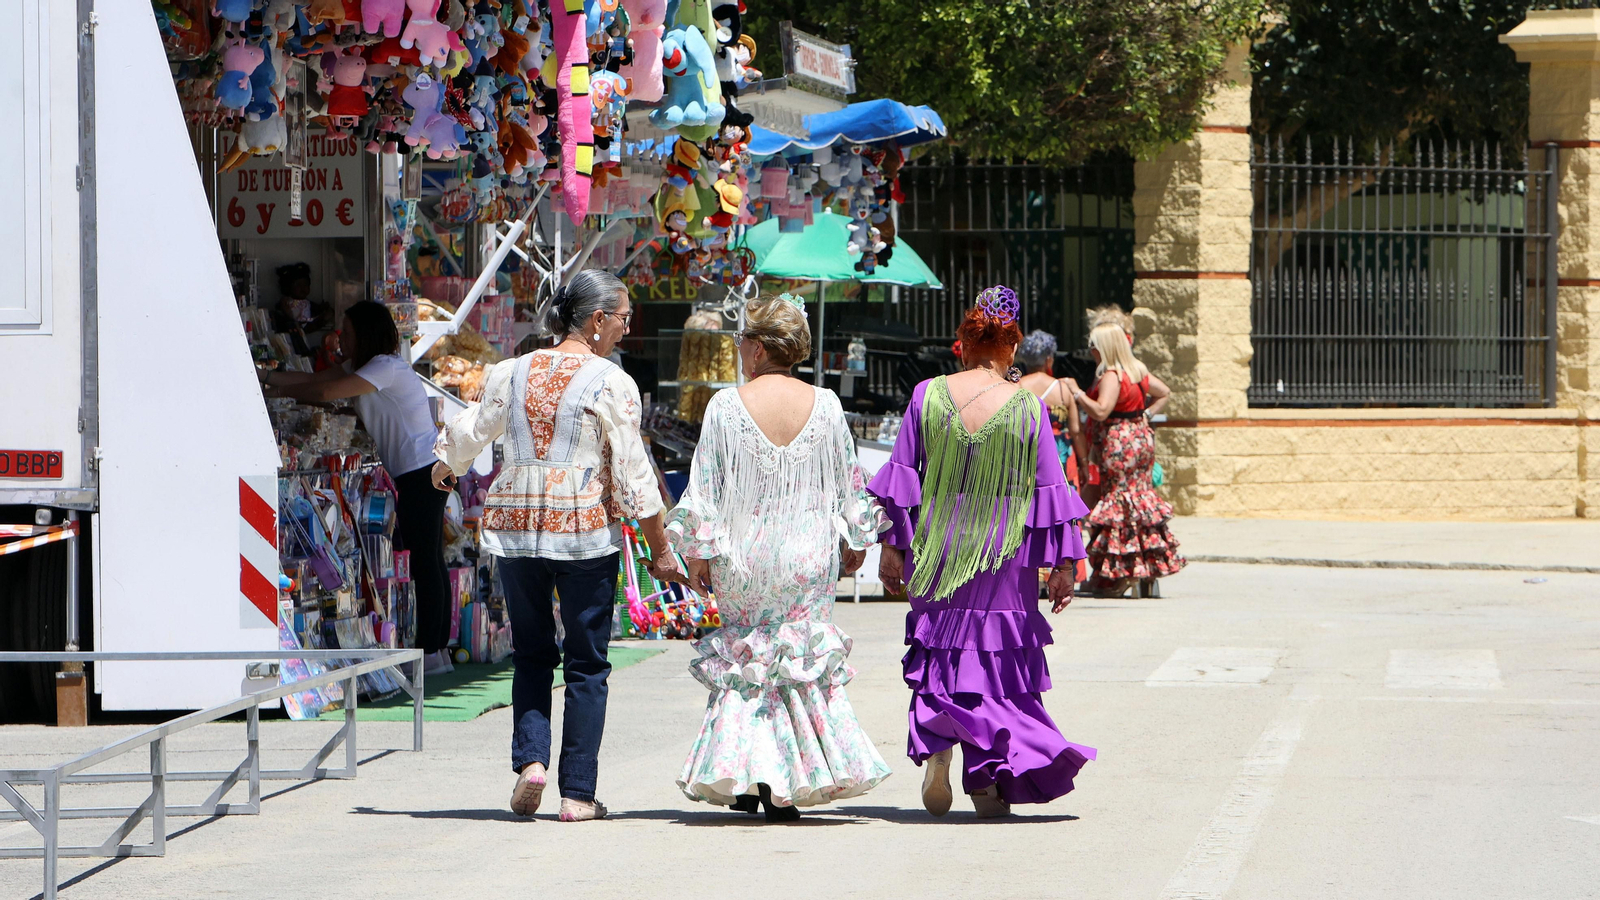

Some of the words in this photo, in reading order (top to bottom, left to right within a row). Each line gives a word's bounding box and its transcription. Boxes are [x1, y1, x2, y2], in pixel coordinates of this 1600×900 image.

[237, 168, 258, 192] DE
[262, 162, 328, 192] TURÓN
[331, 168, 344, 191] A
[227, 196, 246, 228] 6
[256, 202, 276, 235] y
[335, 198, 355, 226] €
[16, 453, 60, 475] BBP
